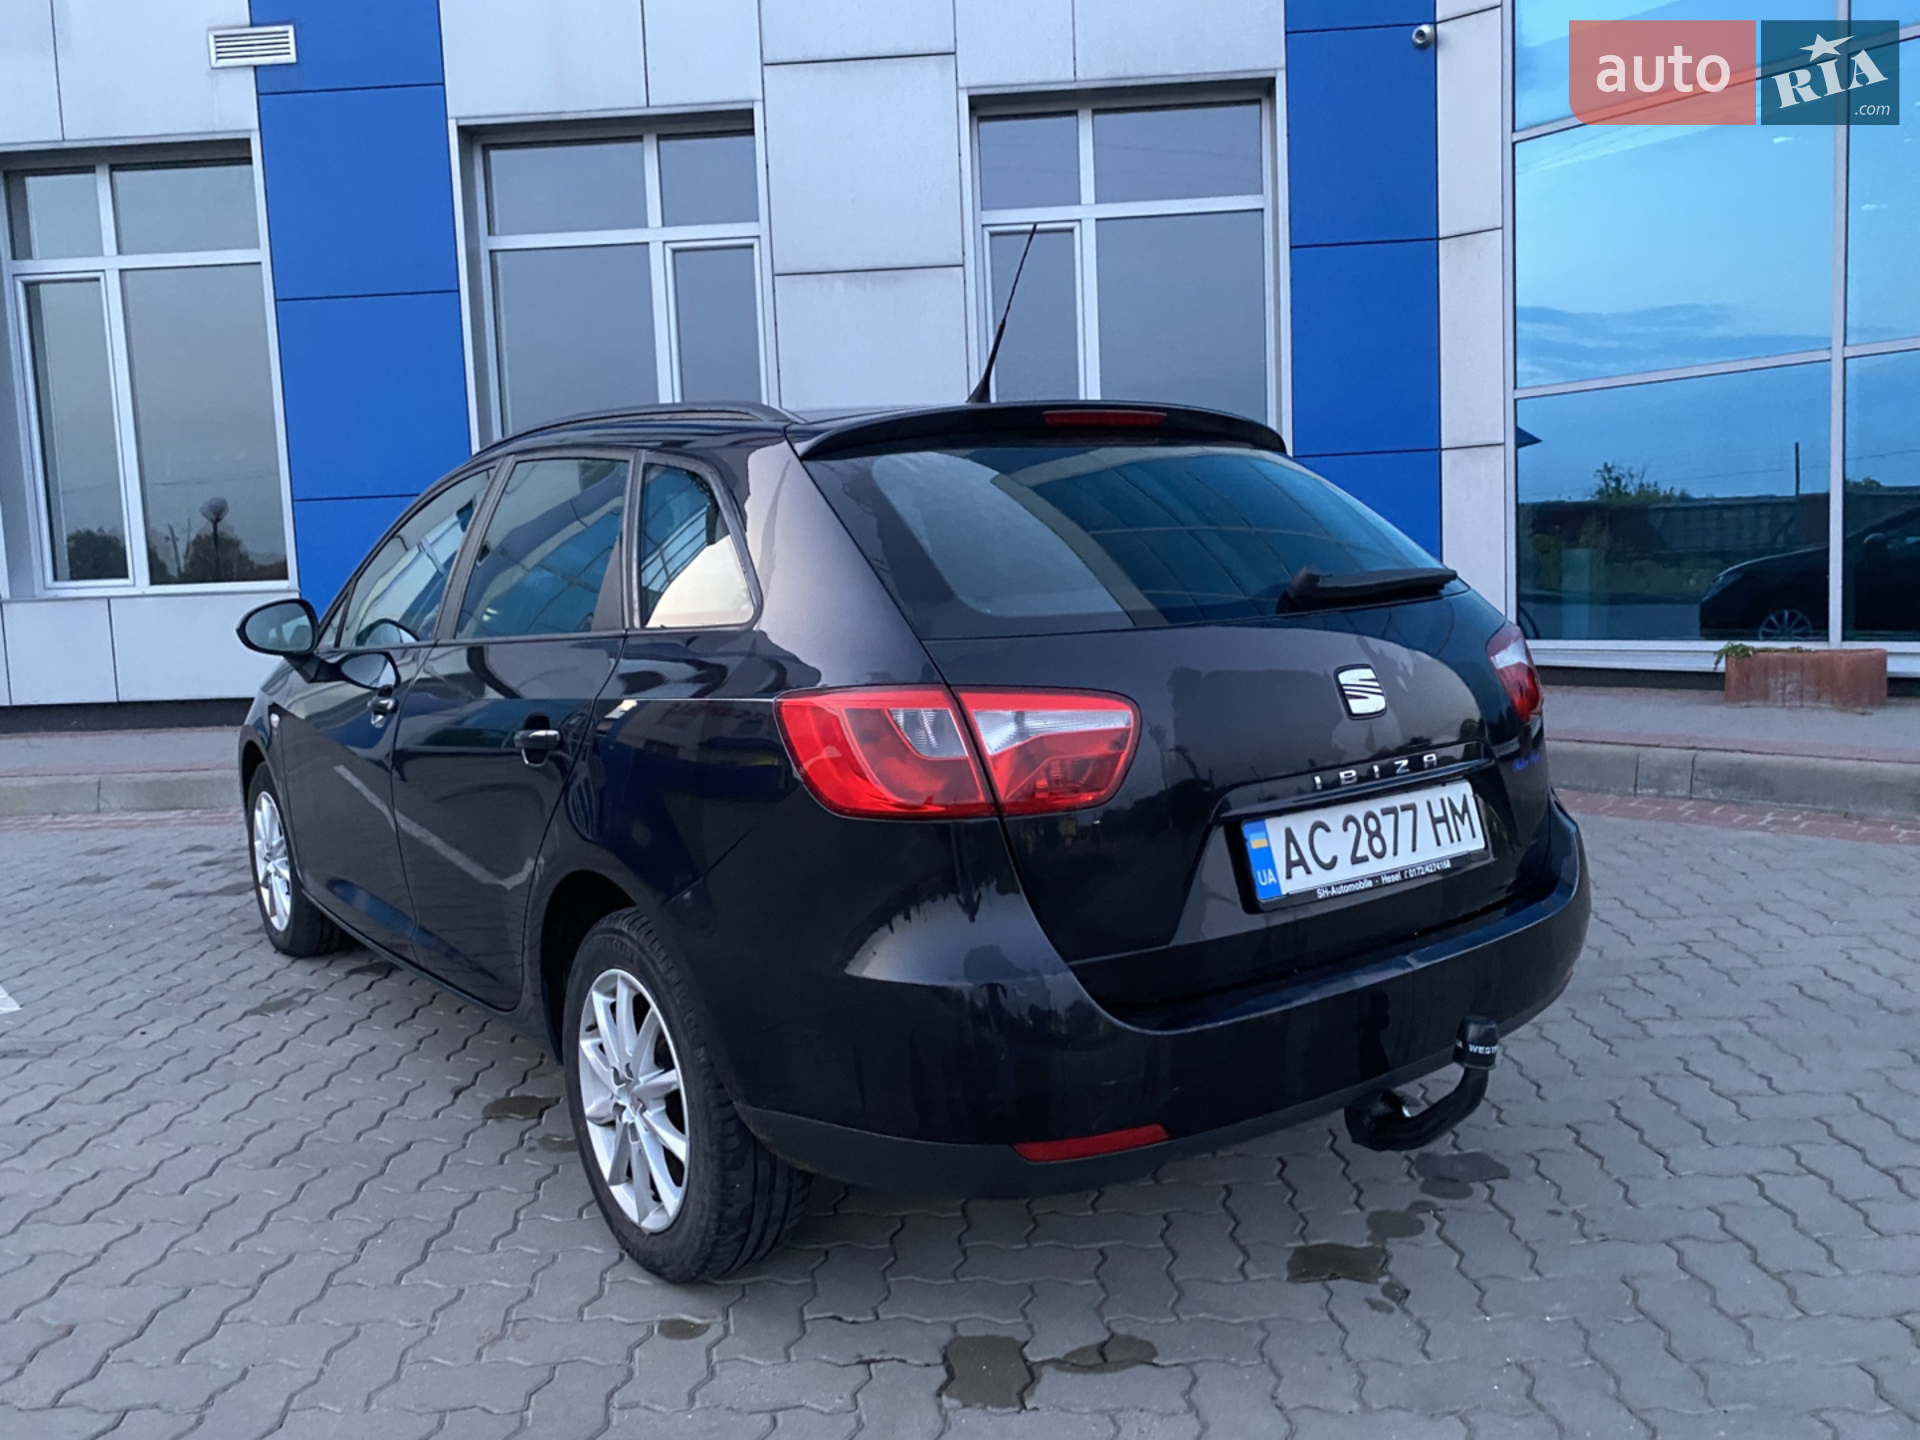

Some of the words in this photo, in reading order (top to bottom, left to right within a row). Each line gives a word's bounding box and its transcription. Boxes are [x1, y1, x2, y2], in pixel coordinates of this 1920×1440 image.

[1314, 752, 1438, 790] IBIZA
[1284, 820, 1339, 881] AC
[1341, 802, 1418, 866] 2877
[1426, 793, 1477, 847] HM
[1257, 869, 1278, 887] UA
[1316, 878, 1374, 899] SH-Automobile
